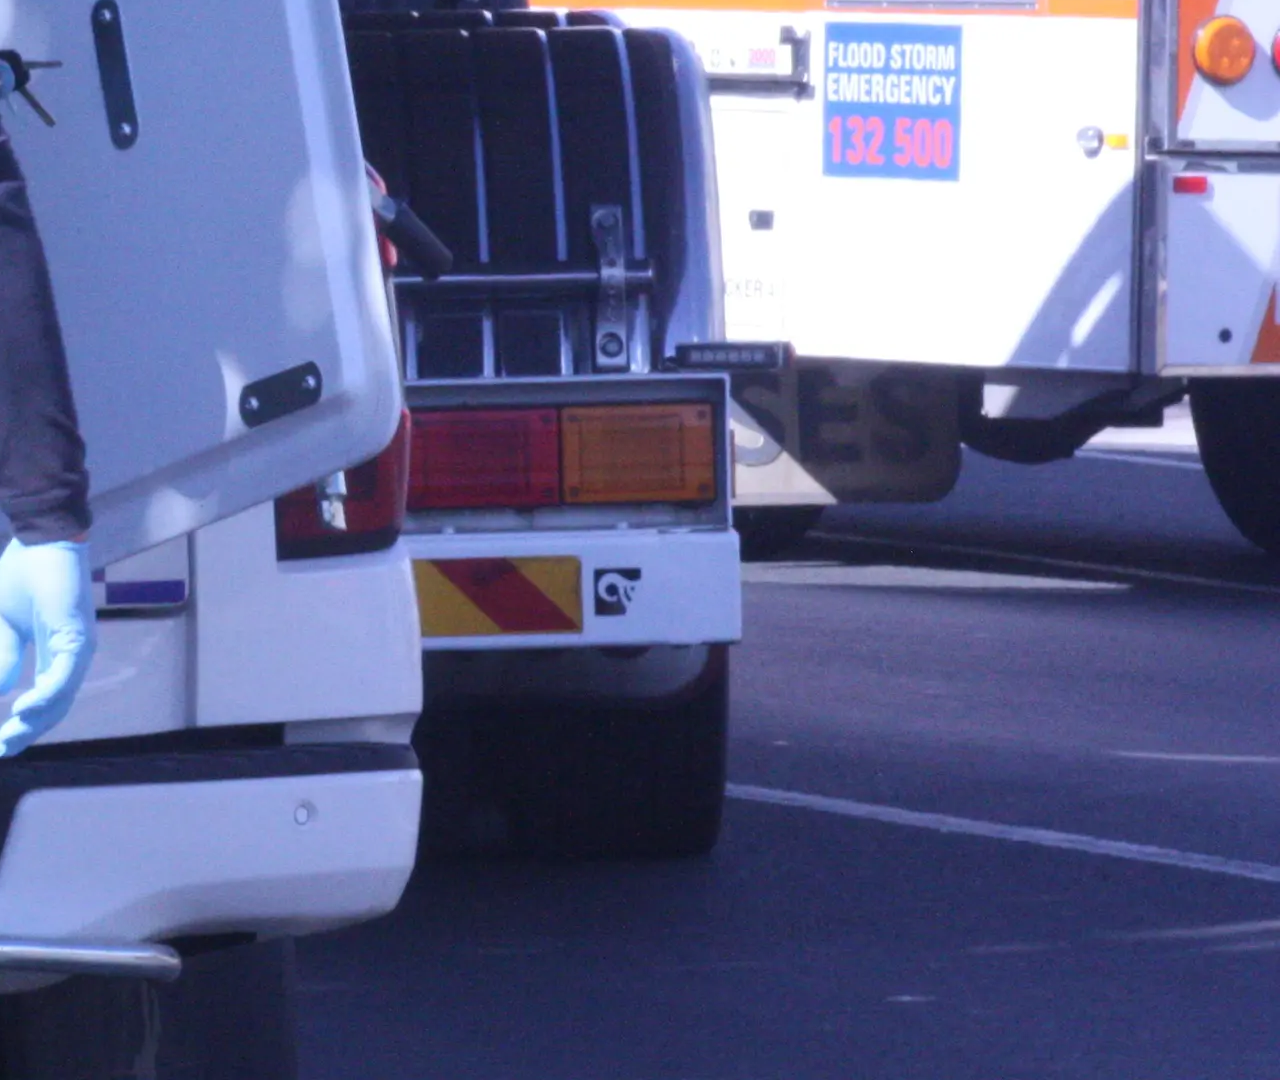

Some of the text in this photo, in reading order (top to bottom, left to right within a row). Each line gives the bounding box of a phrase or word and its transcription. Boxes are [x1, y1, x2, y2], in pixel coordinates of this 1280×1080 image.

[828, 41, 955, 70] FLOOD STORM
[826, 72, 956, 106] EMERGENCY
[828, 114, 953, 169] 132 500
